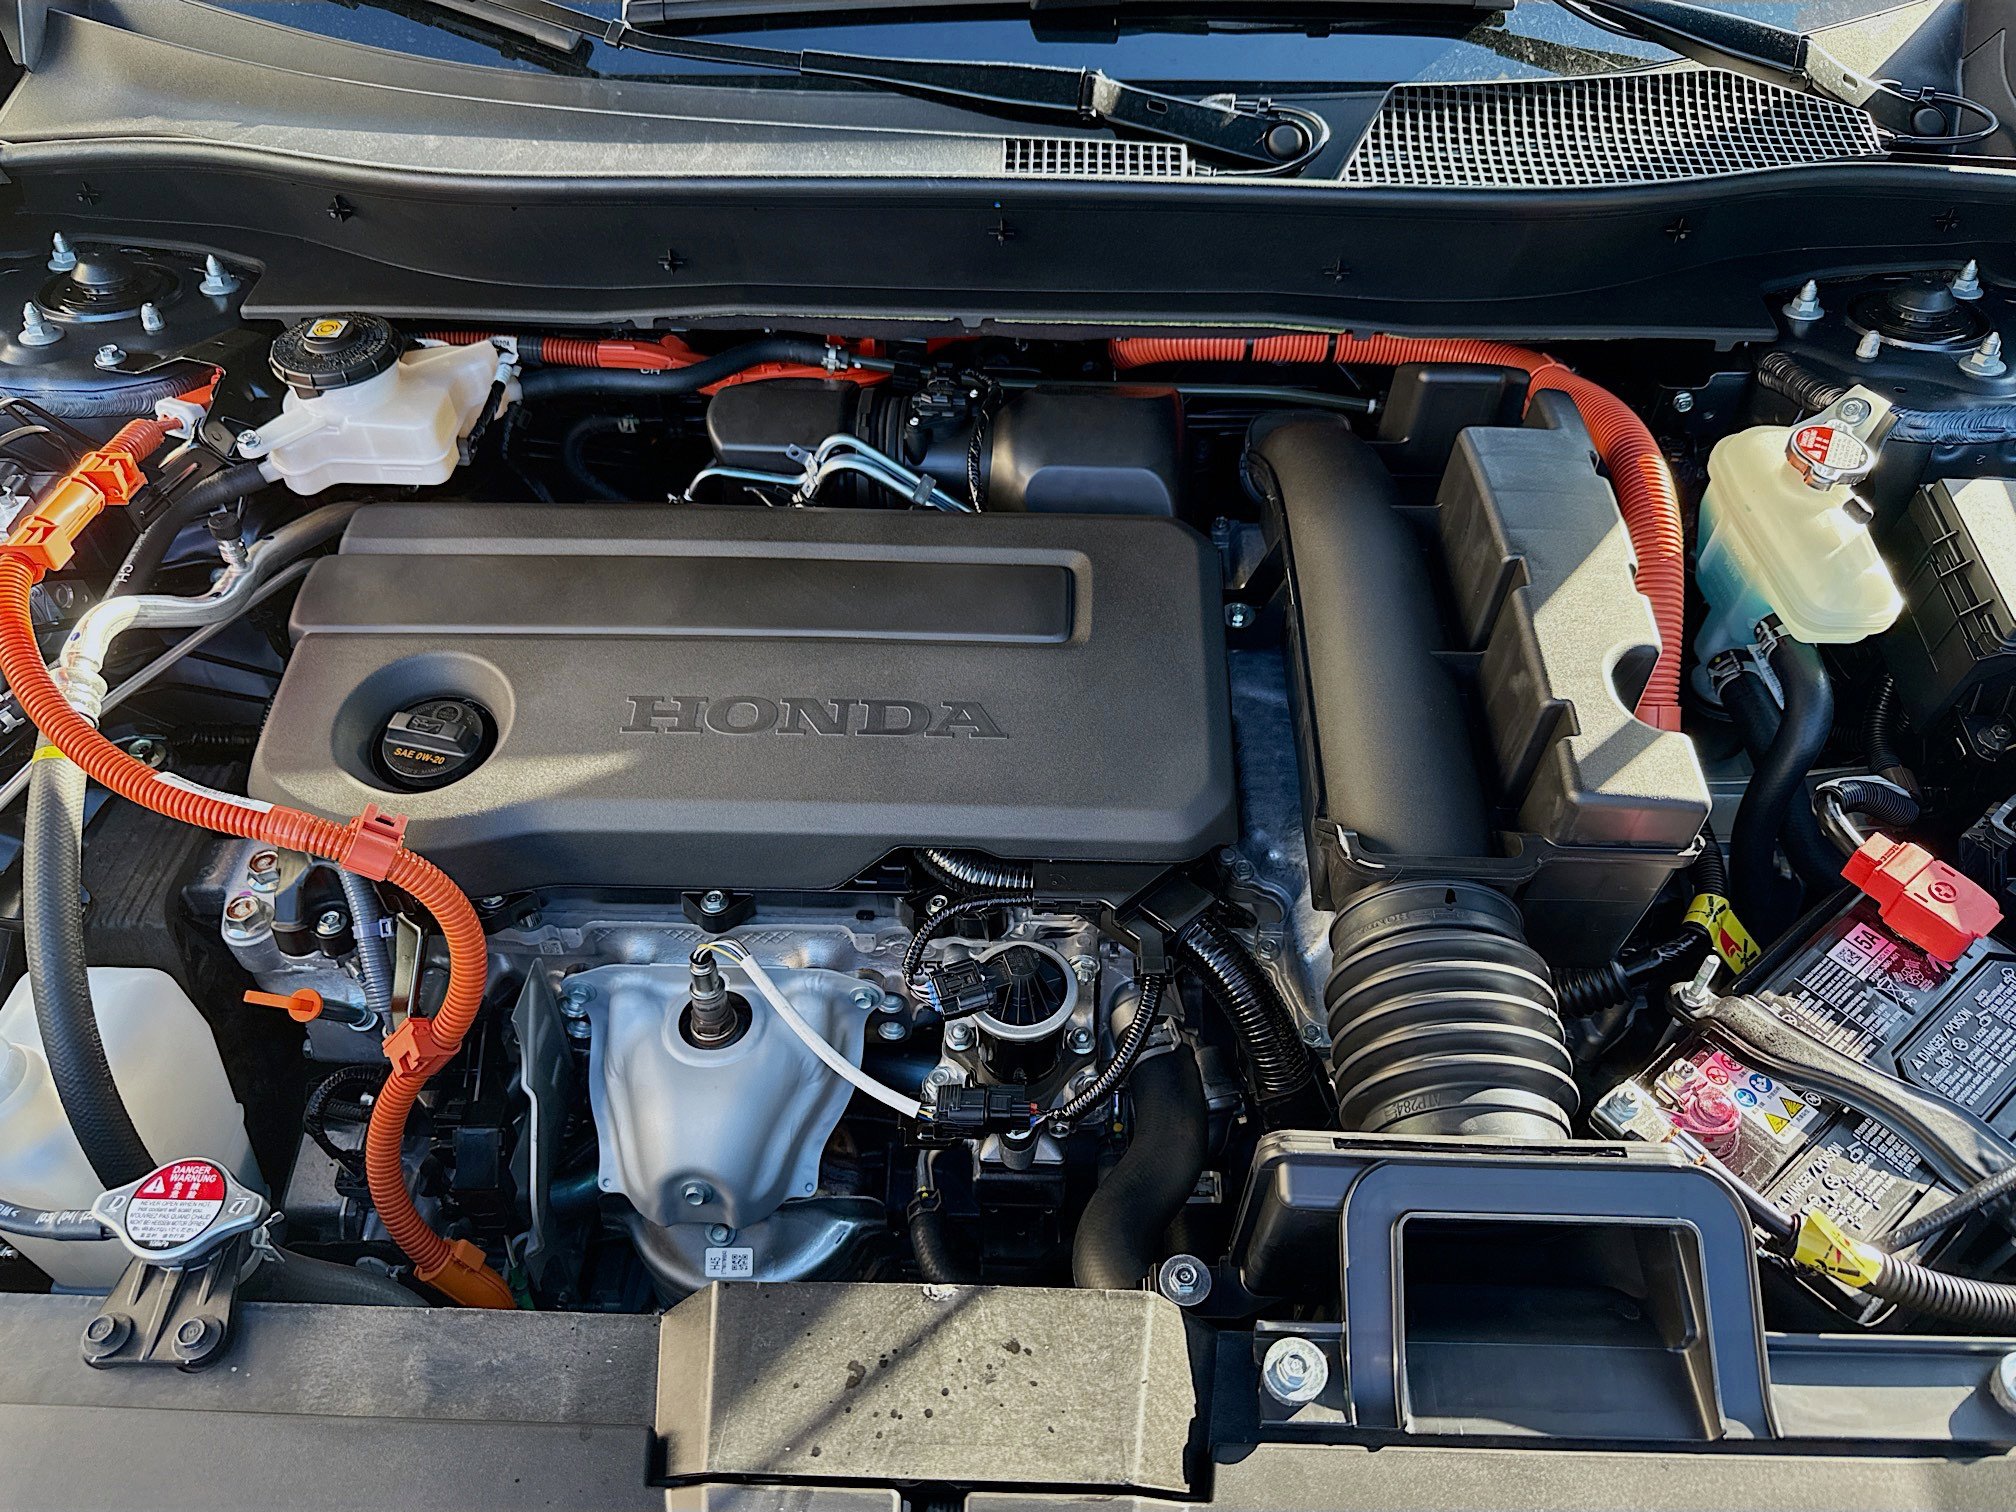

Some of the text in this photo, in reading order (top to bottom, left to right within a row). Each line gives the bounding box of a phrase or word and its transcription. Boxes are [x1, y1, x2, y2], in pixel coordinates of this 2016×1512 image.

[619, 695, 1010, 739] HONDA
[393, 747, 446, 766] SAE 0W-20
[1852, 927, 1881, 950] 5A
[1903, 995, 1918, 1007] Pb
[172, 1166, 212, 1175] DANGER
[170, 1174, 217, 1183] WARNUNG
